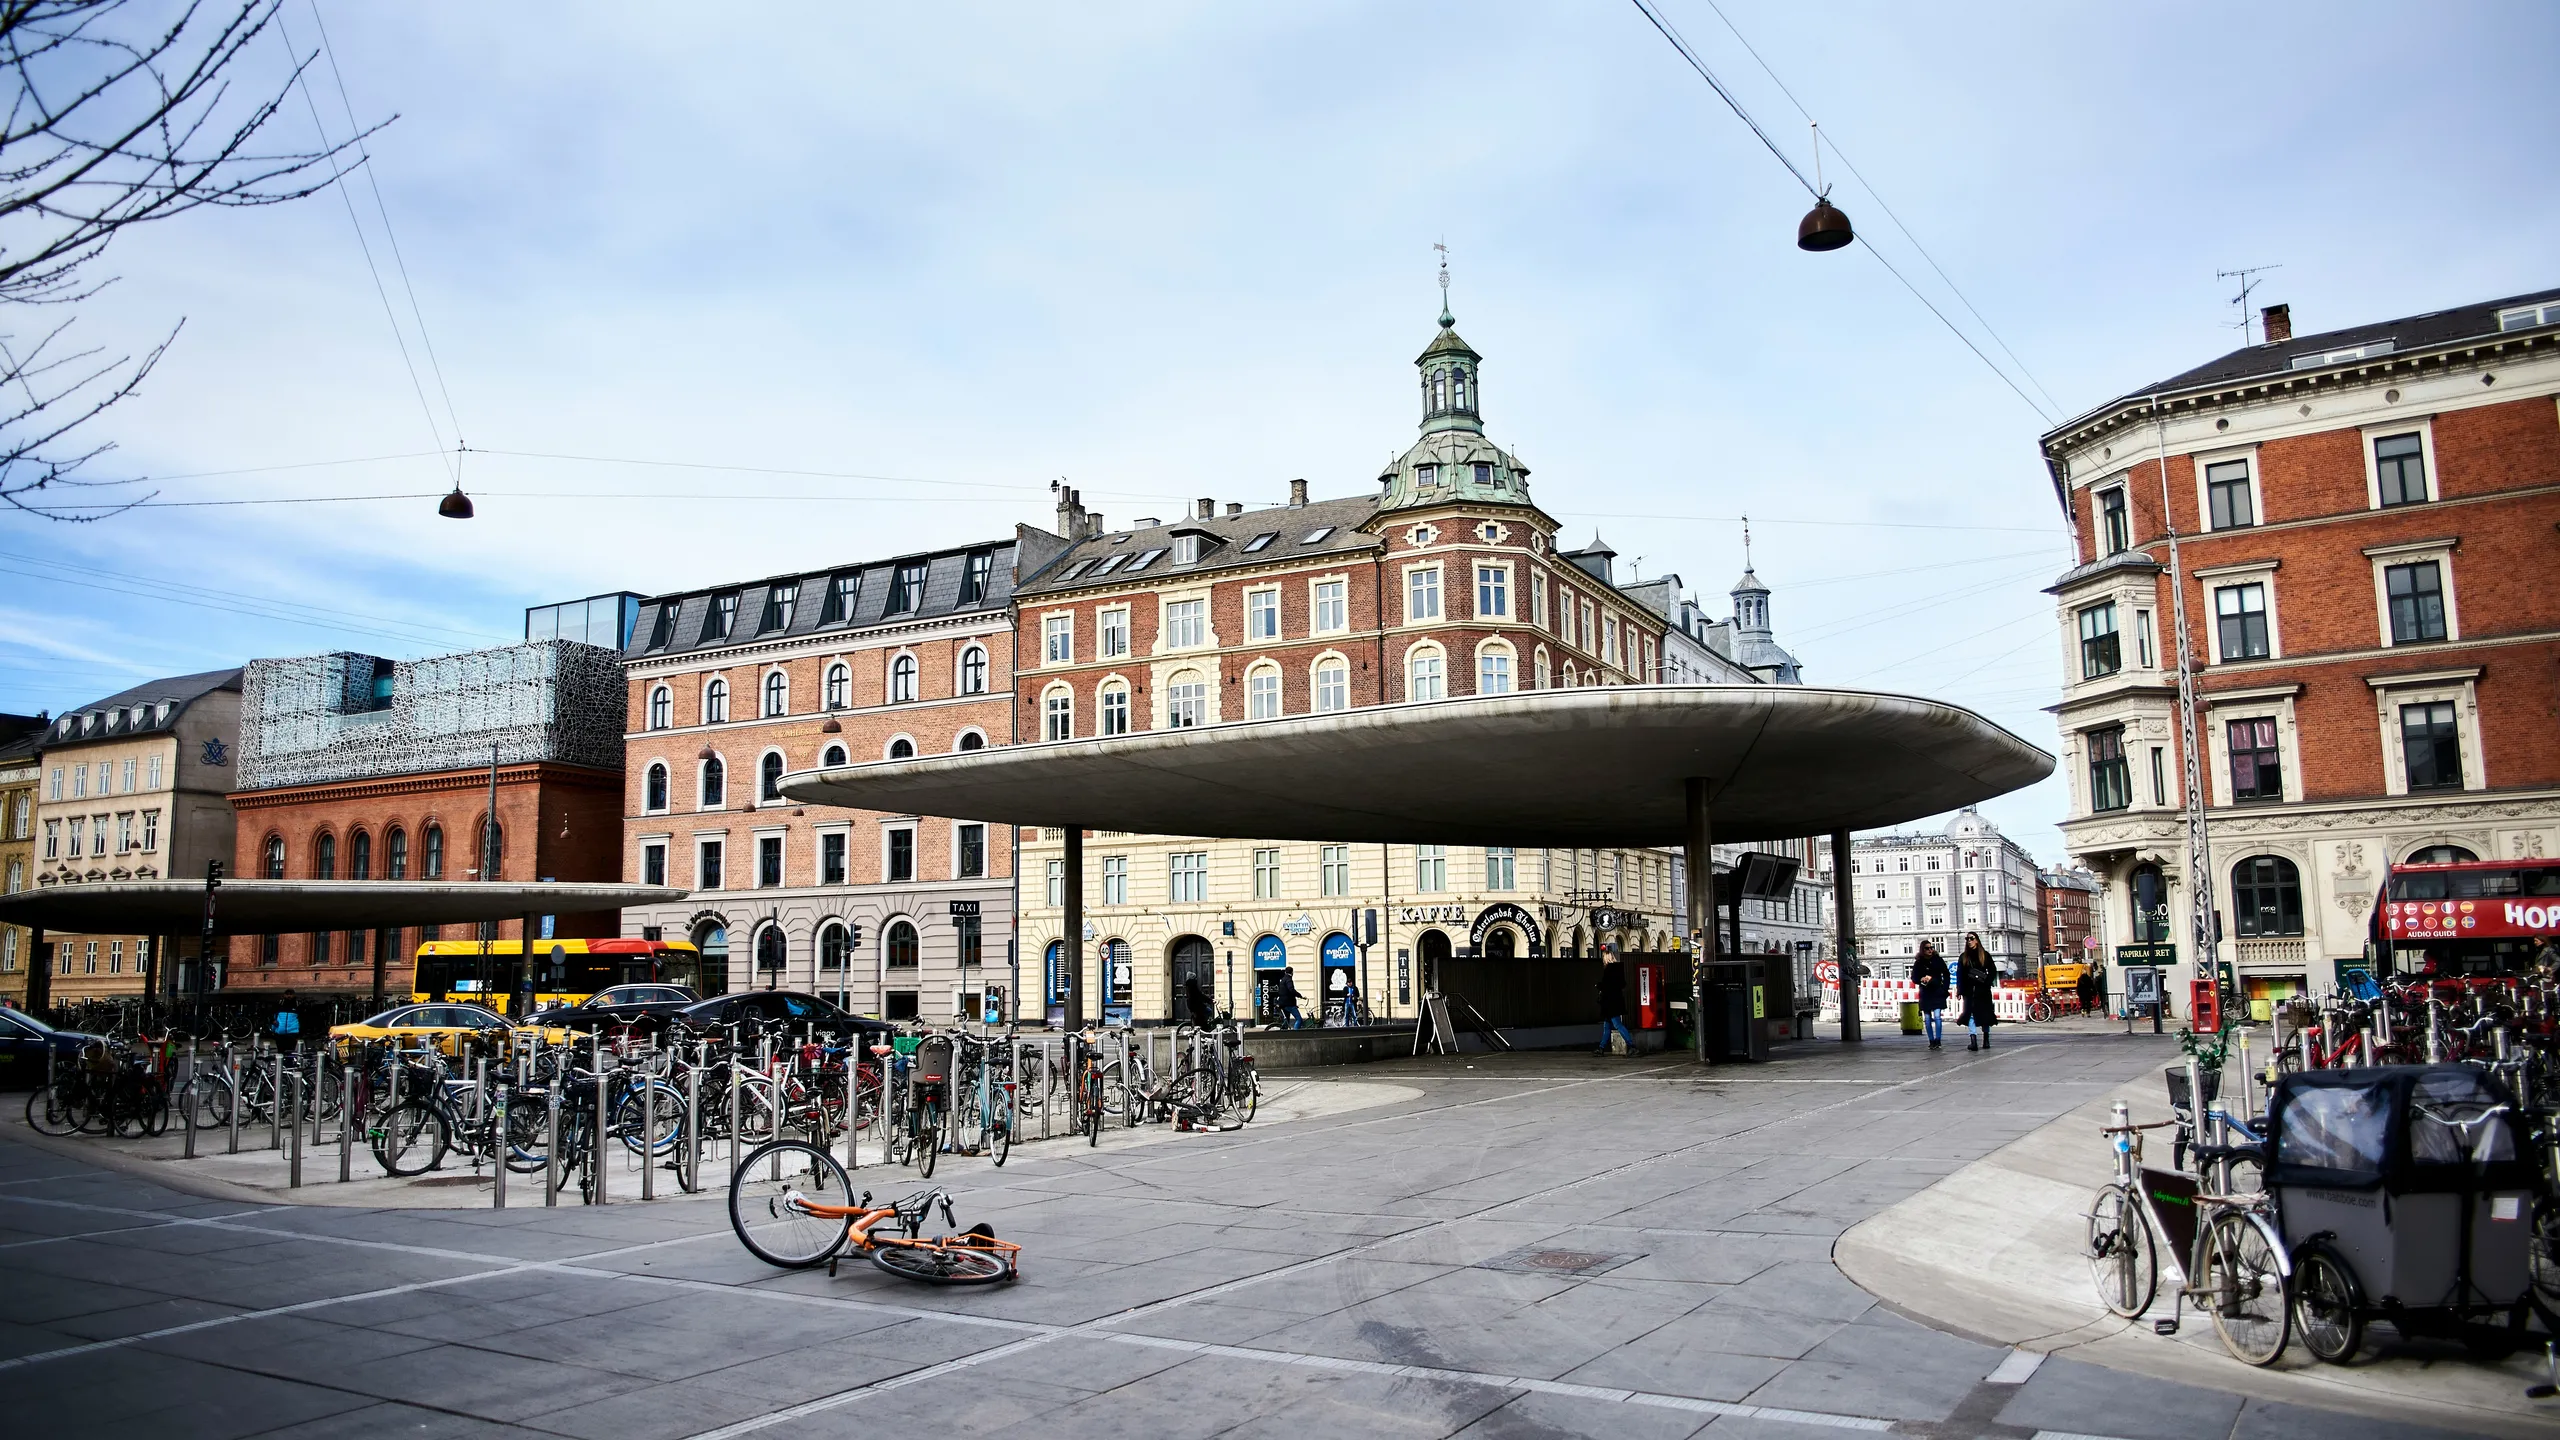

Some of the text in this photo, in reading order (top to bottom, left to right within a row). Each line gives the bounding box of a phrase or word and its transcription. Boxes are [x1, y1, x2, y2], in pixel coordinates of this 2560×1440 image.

[952, 903, 976, 912] TAXI
[1399, 905, 1465, 923] KAFFE
[1101, 945, 1109, 955] 40
[1399, 956, 1408, 989] THE
[1262, 979, 1270, 1016] INDGANG
[815, 1029, 836, 1038] viggo
